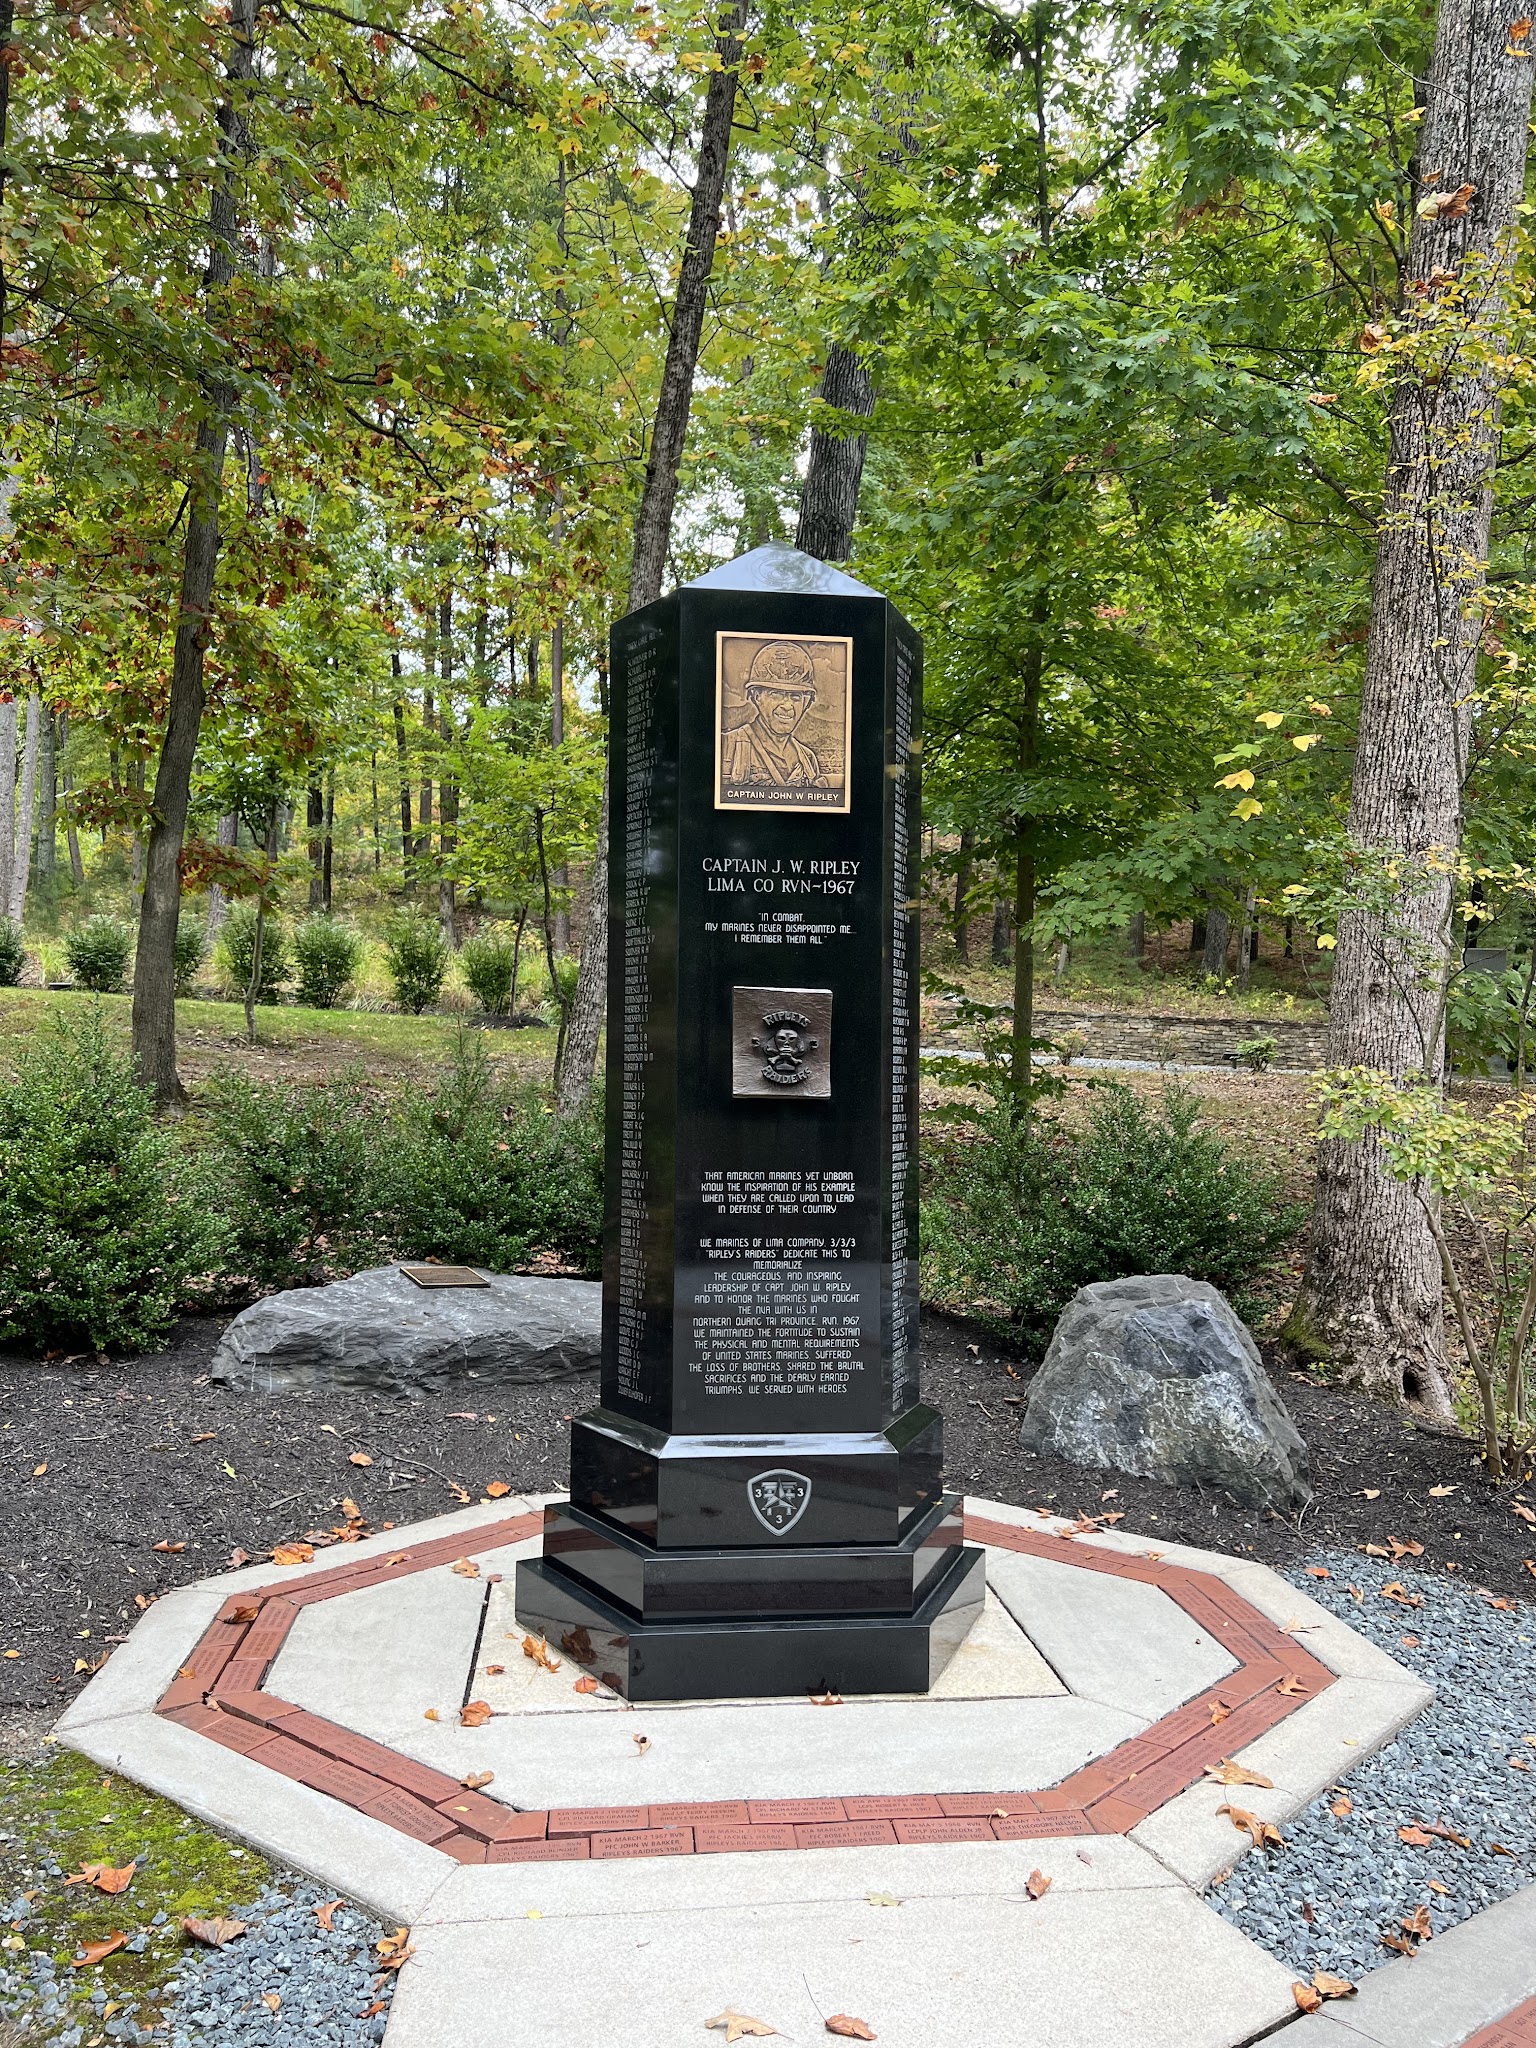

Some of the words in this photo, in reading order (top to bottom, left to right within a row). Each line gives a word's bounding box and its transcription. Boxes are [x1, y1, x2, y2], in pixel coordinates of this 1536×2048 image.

[727, 790, 765, 799] CAPTAIN
[768, 792, 792, 800] JOHN
[795, 792, 804, 800] W
[807, 793, 839, 801] RIPLEY
[702, 858, 766, 873] CAPTAIN
[771, 859, 784, 874] J.
[789, 860, 804, 874] W.
[810, 860, 859, 875] RIPLEY
[708, 878, 744, 892] LIMA
[753, 878, 773, 893] CO
[704, 922, 717, 932] MY
[721, 922, 755, 932] MARINES
[758, 923, 782, 932] NEVER
[785, 924, 836, 933] DISAPPOINTED
[734, 934, 737, 943] I
[740, 934, 782, 944] REMEMBER
[785, 934, 806, 944] THEM
[761, 1065, 812, 1084] RAIDERS
[704, 1171, 723, 1181] THAT
[726, 1171, 764, 1181] AMERICAN
[768, 1171, 801, 1181] MARINES
[805, 1171, 819, 1181] YET
[823, 1171, 853, 1181] UNBORN
[701, 1183, 723, 1192] KNOW
[727, 1183, 740, 1192] THE
[744, 1183, 788, 1192] INSPIRATION
[792, 1183, 801, 1192] OF
[805, 1183, 817, 1192] HIS
[820, 1183, 855, 1192] EXAMPLE
[702, 1194, 723, 1203] WHEN
[727, 1194, 746, 1203] THEY
[749, 1194, 764, 1203] ARE
[767, 1194, 795, 1203] CALLED
[798, 1194, 818, 1203] UPON
[822, 1194, 831, 1202] TO
[835, 1194, 854, 1202] LEAD
[718, 1204, 725, 1214] IN
[729, 1204, 761, 1214] DEFENSE
[765, 1204, 774, 1214] OF
[778, 1204, 798, 1214] THEIR
[699, 1238, 711, 1247] WE
[715, 1238, 749, 1247] MARINES
[752, 1238, 762, 1247] OF
[765, 1238, 783, 1247] LIMA
[830, 1238, 855, 1247] 3/3/3
[784, 1249, 818, 1258] DEDICATE
[822, 1249, 837, 1258] THIS
[841, 1249, 850, 1258] TO
[753, 1261, 802, 1270] MEMORIALIZE
[713, 1272, 727, 1281] THE
[786, 1272, 802, 1281] AND
[806, 1272, 841, 1281] INSPIRING
[704, 1283, 749, 1292] LEADERSHIP
[752, 1283, 762, 1292] OF
[790, 1283, 809, 1292] JOHN
[826, 1283, 851, 1292] RIPLEY
[694, 1294, 710, 1304] AND
[713, 1294, 722, 1304] TO
[726, 1294, 751, 1304] HONOR
[755, 1294, 768, 1304] THE
[772, 1294, 806, 1303] MARINES
[809, 1294, 827, 1303] WHO
[831, 1294, 860, 1303] FOUGHT
[738, 1306, 752, 1315] THE
[755, 1306, 770, 1315] NVA
[774, 1305, 792, 1314] WITH
[796, 1305, 806, 1314] US
[810, 1305, 817, 1314] IN
[692, 1317, 730, 1327] NORTHERN
[734, 1317, 761, 1326] QUANG
[764, 1317, 775, 1326] TRI
[842, 1316, 859, 1326] 1967
[693, 1329, 705, 1338] WE
[709, 1328, 755, 1338] MAINTAINED
[758, 1328, 772, 1337] THE
[776, 1328, 813, 1337] FORTITUDE
[817, 1328, 826, 1337] TO
[830, 1327, 860, 1337] SUSTAIN
[694, 1340, 708, 1349] THE
[711, 1340, 748, 1349] PHYSICAL
[751, 1340, 767, 1349] AND
[771, 1339, 800, 1349] MENTAL
[804, 1339, 859, 1349] REQUIREMENTS
[702, 1351, 711, 1360] OF
[715, 1351, 740, 1360] UNITED
[744, 1351, 771, 1360] STATES
[814, 1350, 851, 1360] SUFFERED
[688, 1363, 702, 1372] THE
[706, 1363, 725, 1372] LOSS
[729, 1362, 738, 1372] OF
[786, 1362, 816, 1372] SHARED
[819, 1362, 833, 1371] THE
[837, 1361, 864, 1371] BRUTAL
[704, 1374, 746, 1384] SACRIFICES
[749, 1373, 765, 1383] AND
[769, 1373, 782, 1383] THE
[786, 1373, 815, 1383] DEARLY
[819, 1373, 849, 1382] EARNED
[747, 1385, 759, 1394] WE
[763, 1384, 792, 1394] SERVED
[796, 1384, 813, 1394] WITH
[755, 1488, 762, 1498] 3
[797, 1488, 804, 1497] 3
[776, 1515, 782, 1524] 3
